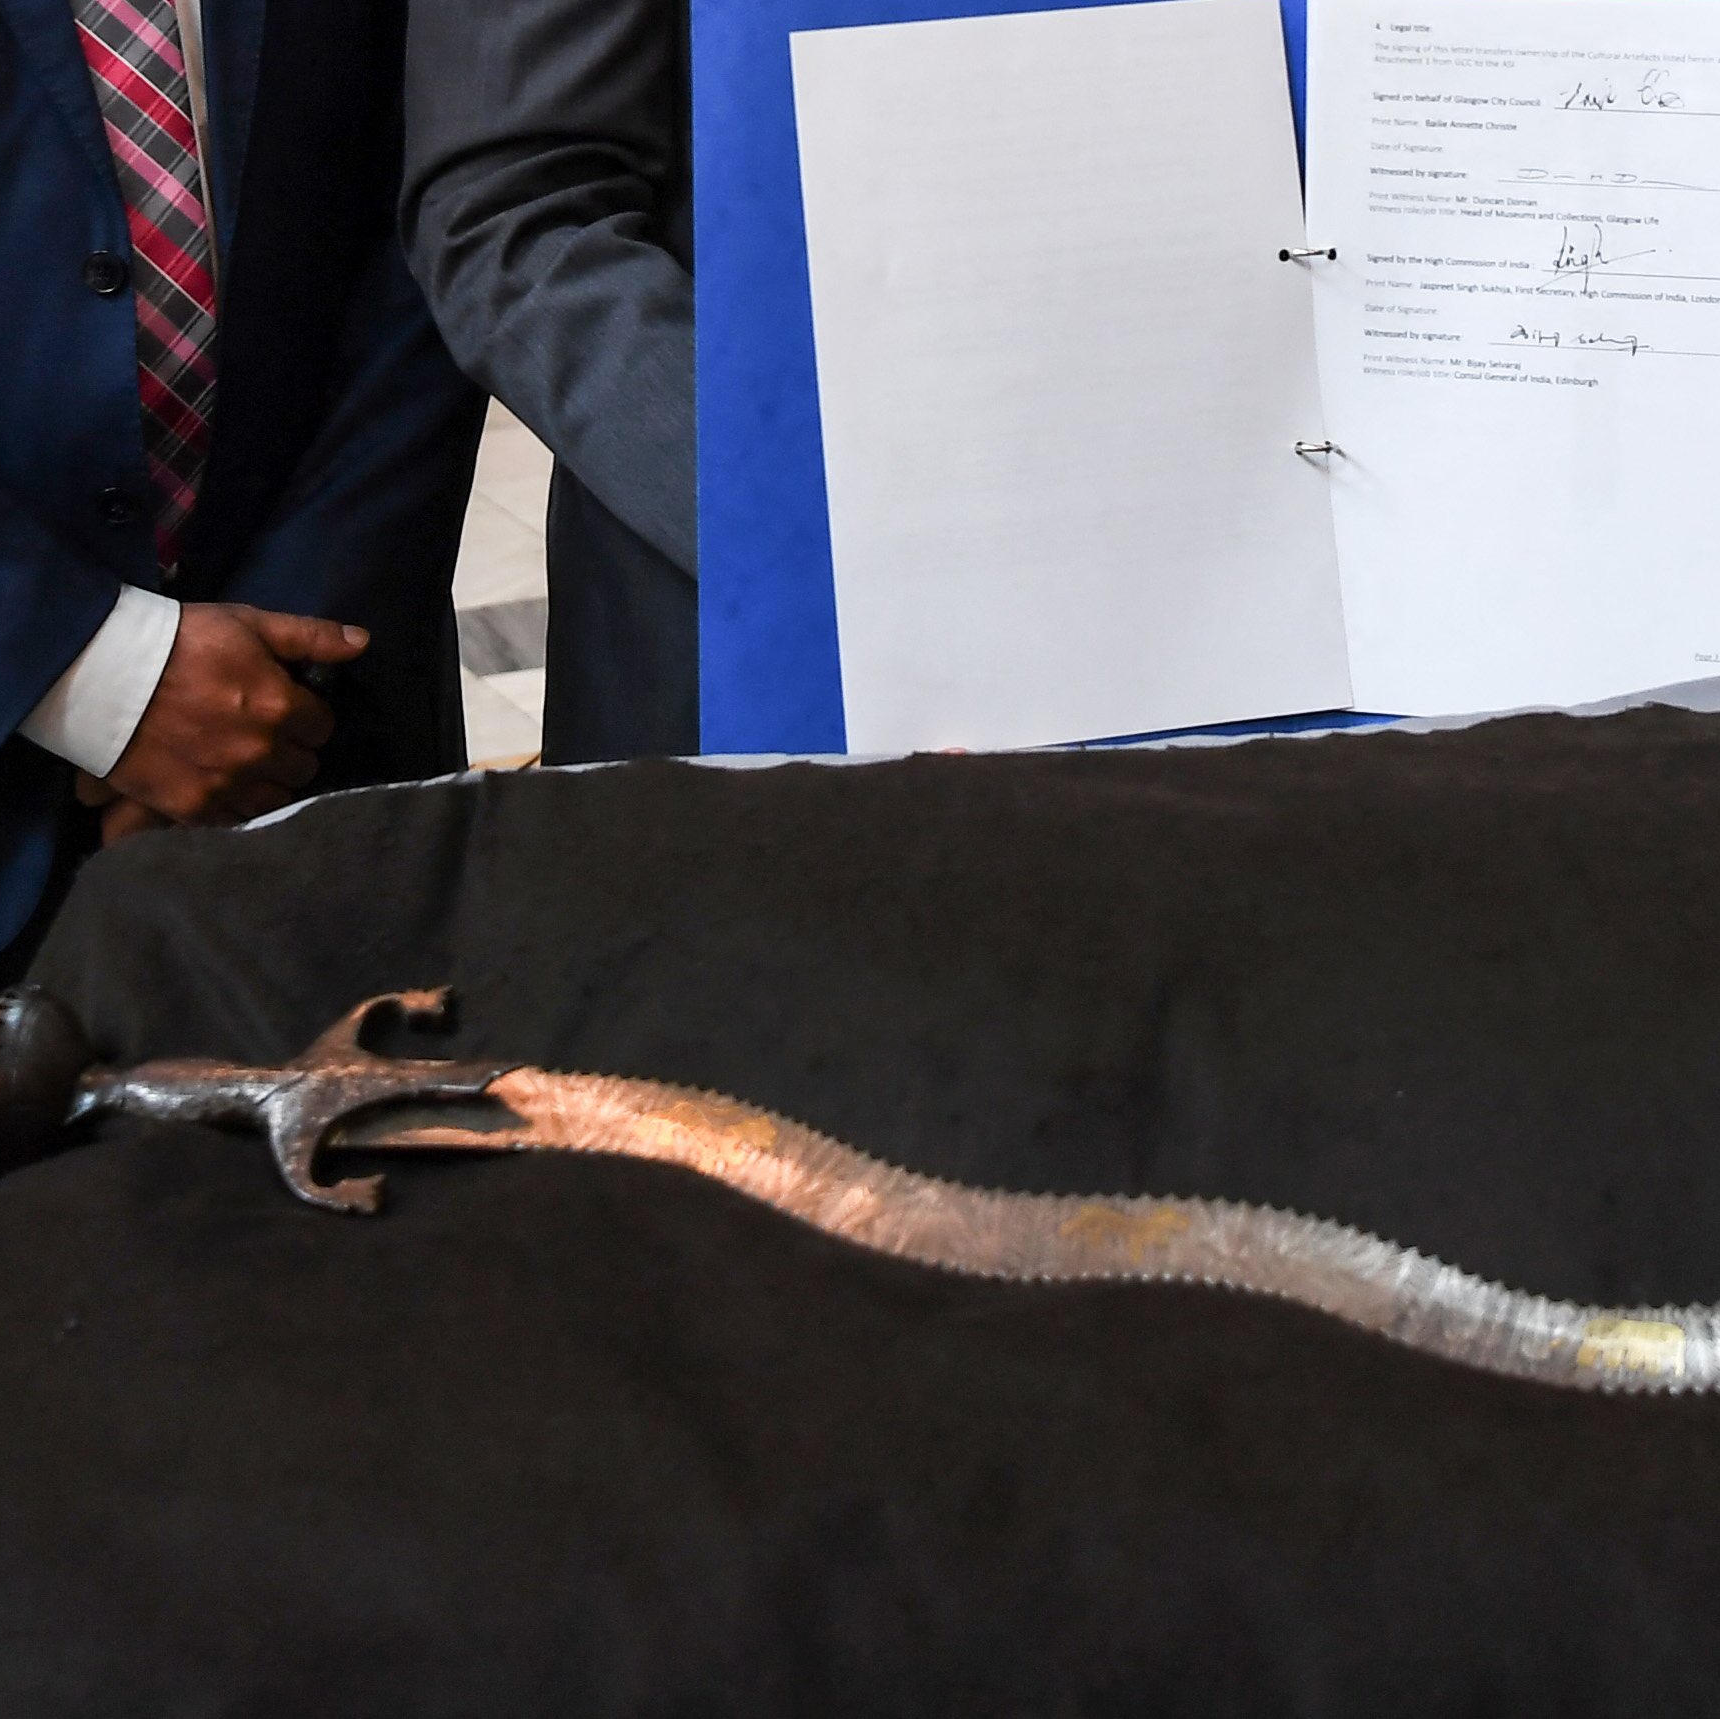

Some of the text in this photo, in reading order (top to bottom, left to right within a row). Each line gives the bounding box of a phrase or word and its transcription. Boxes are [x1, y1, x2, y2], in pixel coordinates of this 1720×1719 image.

[1390, 23, 1411, 33] Legal
[1375, 42, 1389, 50] The
[1423, 44, 1432, 53] of
[1433, 45, 1449, 53] this
[1451, 46, 1473, 54] letter
[1475, 46, 1512, 55] transfers
[1561, 50, 1570, 58] of
[1572, 50, 1585, 58] the
[1587, 51, 1621, 60] Cultural
[1622, 52, 1660, 62] Artefacts
[1663, 53, 1686, 62] listed
[1374, 55, 1422, 64] Attachment
[1433, 57, 1452, 66] from
[1455, 58, 1473, 67] GCC
[1475, 59, 1483, 67] to
[1485, 59, 1499, 68] the
[1373, 92, 1400, 102] Signed
[1415, 94, 1441, 102] behalf
[1443, 95, 1452, 103] of
[1454, 96, 1488, 106] Glasgow
[1491, 97, 1507, 106] City
[1450, 120, 1483, 129] Annette
[1485, 121, 1517, 131] Christie
[1393, 143, 1402, 151] of
[1370, 167, 1413, 177] Witnessed
[1416, 169, 1425, 178] by
[1391, 192, 1424, 202] Witness
[1473, 196, 1504, 205] Duncan
[1369, 205, 1401, 213] Witness
[1460, 208, 1482, 217] Head
[1484, 209, 1493, 217] of
[1495, 210, 1535, 219] Museums
[1538, 211, 1554, 220] and
[1606, 214, 1641, 225] Glasgow
[1644, 216, 1659, 225] Life
[1367, 254, 1394, 264] Signed
[1396, 255, 1406, 264] by
[1409, 256, 1422, 264] the
[1425, 256, 1443, 266] High
[1446, 258, 1496, 267] Commission
[1498, 259, 1507, 268] of
[1419, 281, 1454, 292] Jaspreet
[1456, 282, 1479, 293] Singh
[1516, 285, 1533, 295] First
[1580, 290, 1599, 299] High
[1601, 290, 1652, 301] Commission
[1655, 291, 1664, 300] of
[1387, 304, 1396, 313] of
[1363, 328, 1408, 339] Witnessed
[1410, 330, 1419, 341] by
[1385, 354, 1417, 364] Witness
[1467, 359, 1486, 370] Bijay
[1489, 359, 1521, 371] Selvaraj
[1454, 370, 1482, 380] Consul
[1484, 371, 1517, 382] General
[1519, 373, 1529, 383] of
[1555, 375, 1599, 387] Edinburgh
